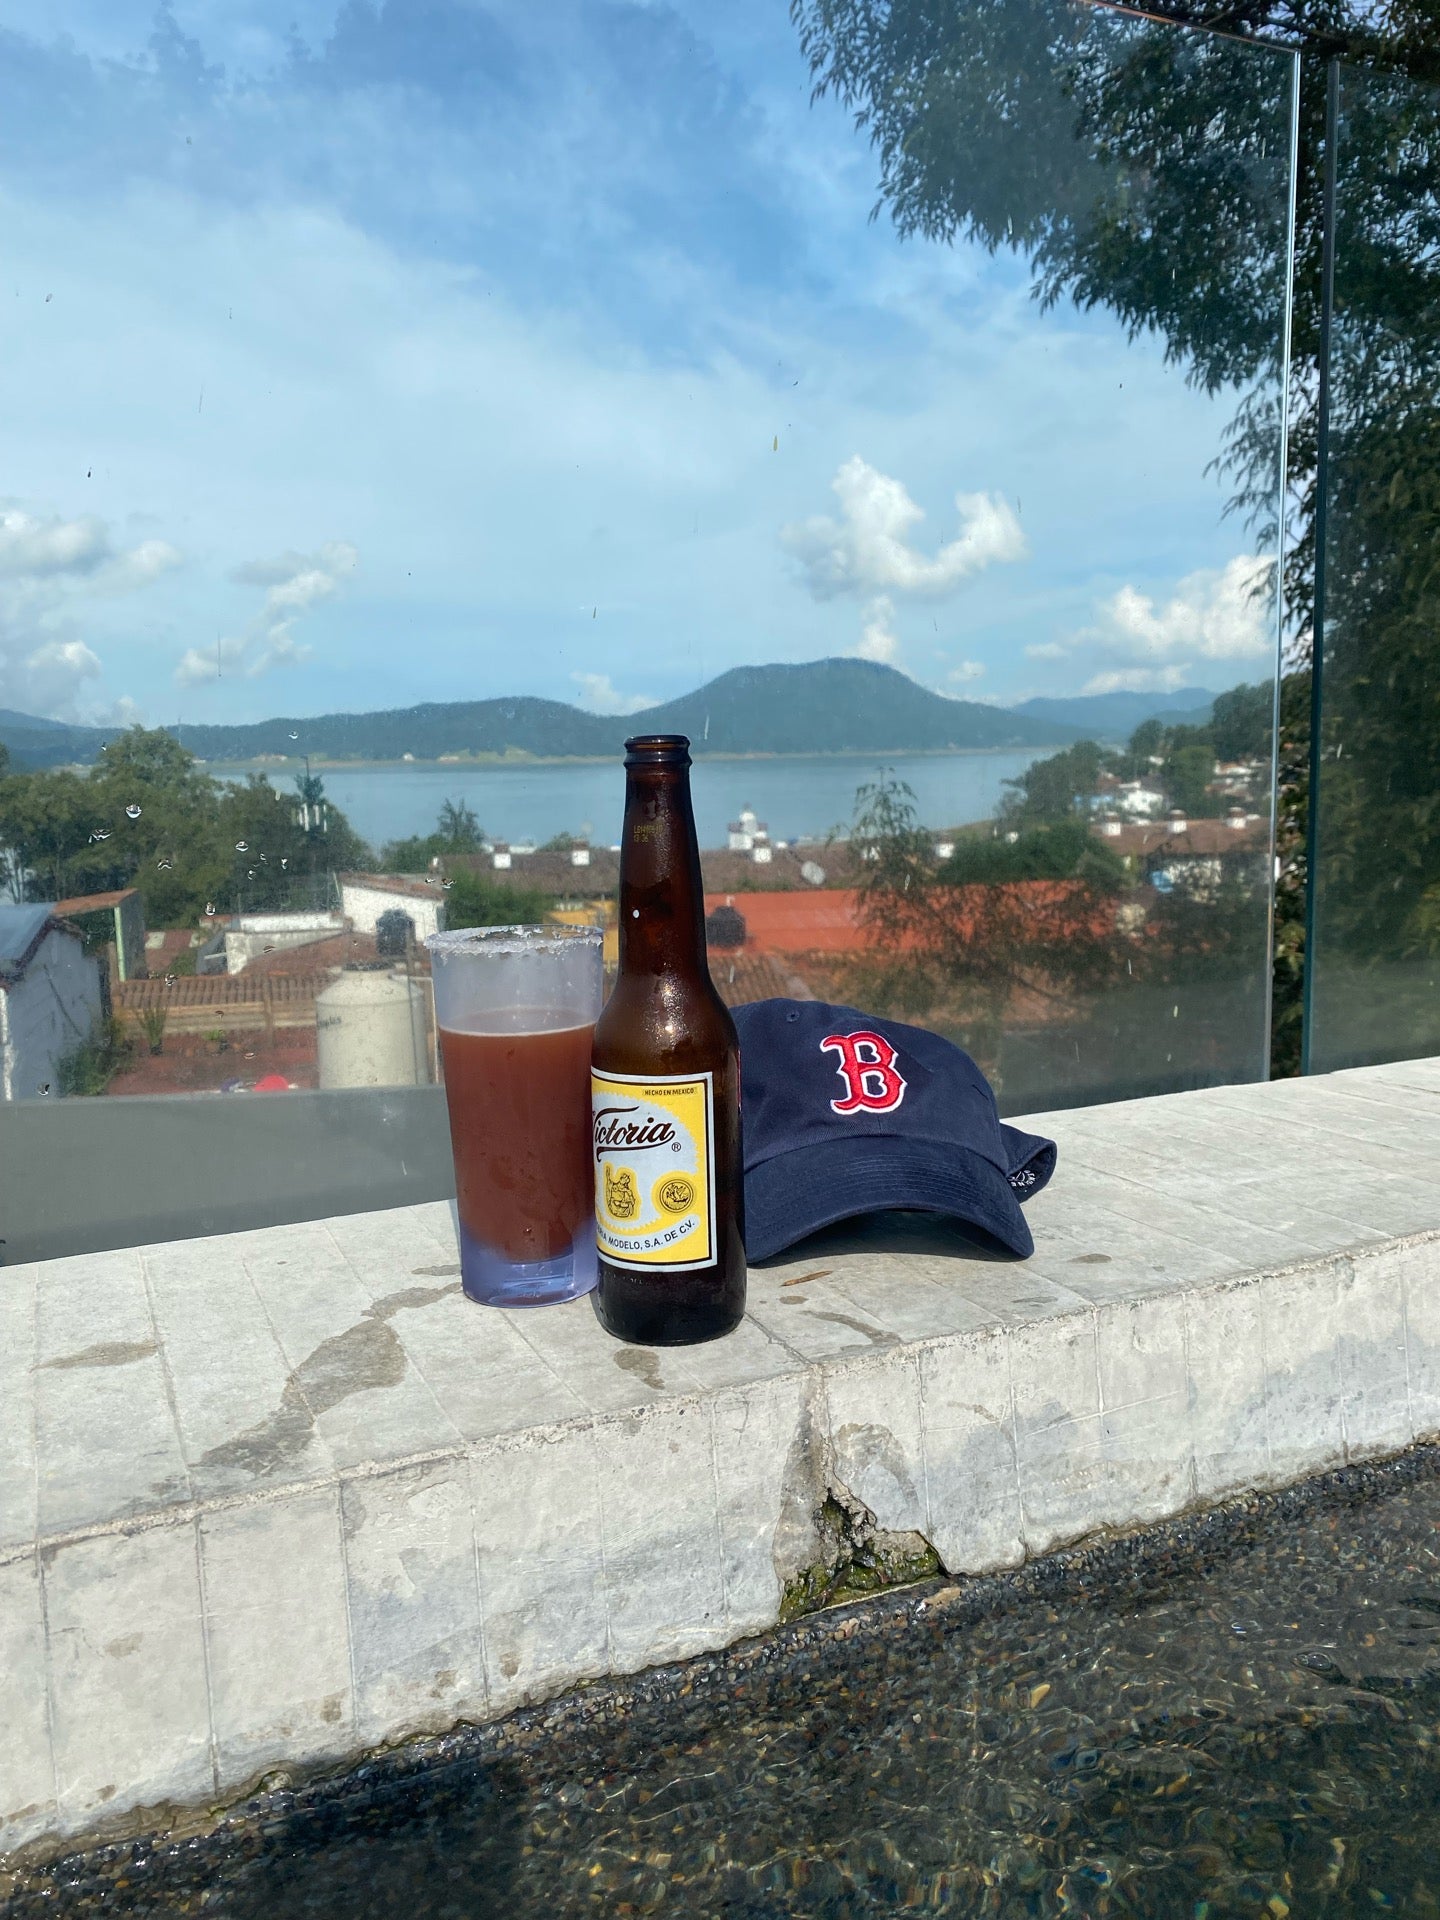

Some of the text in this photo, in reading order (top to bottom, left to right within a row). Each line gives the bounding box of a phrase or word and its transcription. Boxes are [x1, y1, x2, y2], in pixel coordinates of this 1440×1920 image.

[819, 1031, 908, 1115] B
[672, 1087, 695, 1095] MEXICO
[644, 1238, 663, 1249] S.A.
[664, 1230, 678, 1242] DE
[679, 1220, 696, 1234] C.V.
